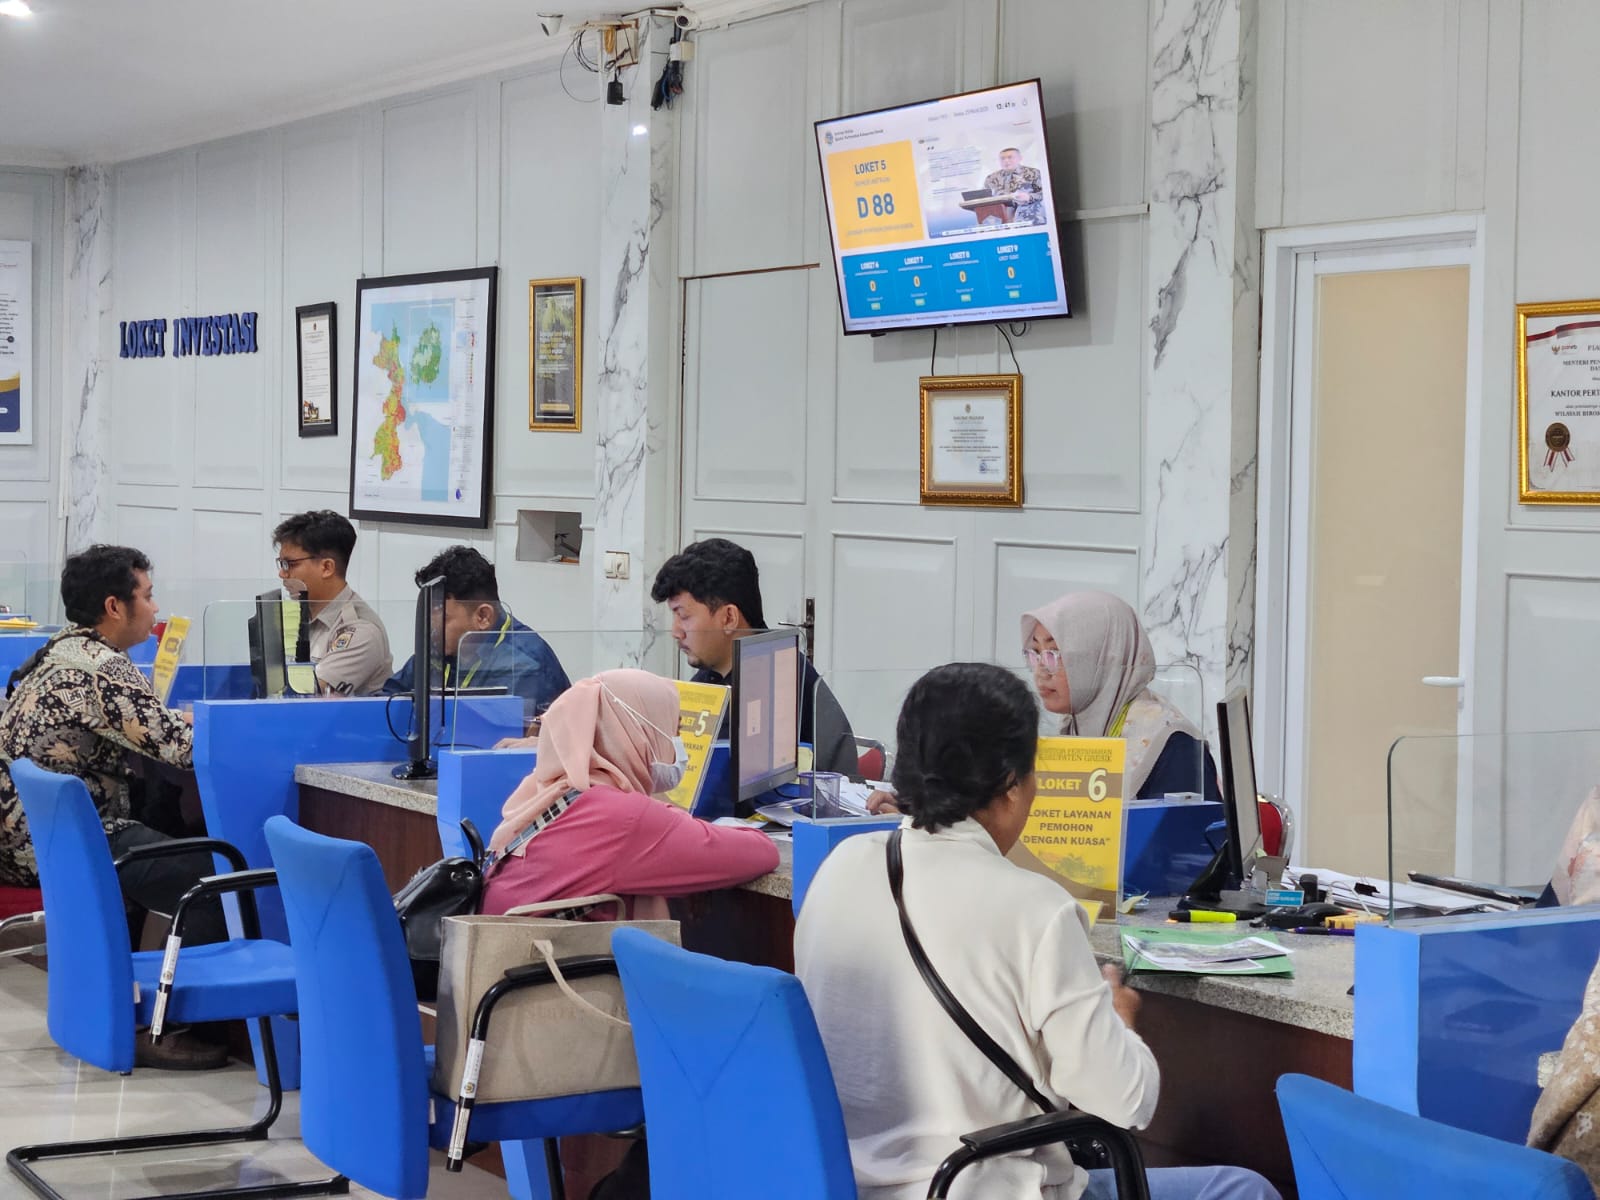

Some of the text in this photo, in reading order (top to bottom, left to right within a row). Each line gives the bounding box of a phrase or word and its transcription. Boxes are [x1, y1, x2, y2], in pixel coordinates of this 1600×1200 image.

[855, 160, 887, 175] LOKET 5
[857, 193, 895, 218] D 88
[959, 270, 967, 283] 0
[1007, 266, 1015, 279] 0
[869, 280, 877, 292] 0
[913, 275, 921, 288] 0
[119, 312, 258, 359] LOKET INVESTASI
[1551, 389, 1581, 398] KANTOR
[694, 710, 710, 737] 5
[1037, 768, 1109, 802] LOKET 6
[1064, 810, 1112, 819] LAYANAN
[1040, 822, 1093, 832] PEMOHON
[1023, 835, 1068, 844] DENGAN
